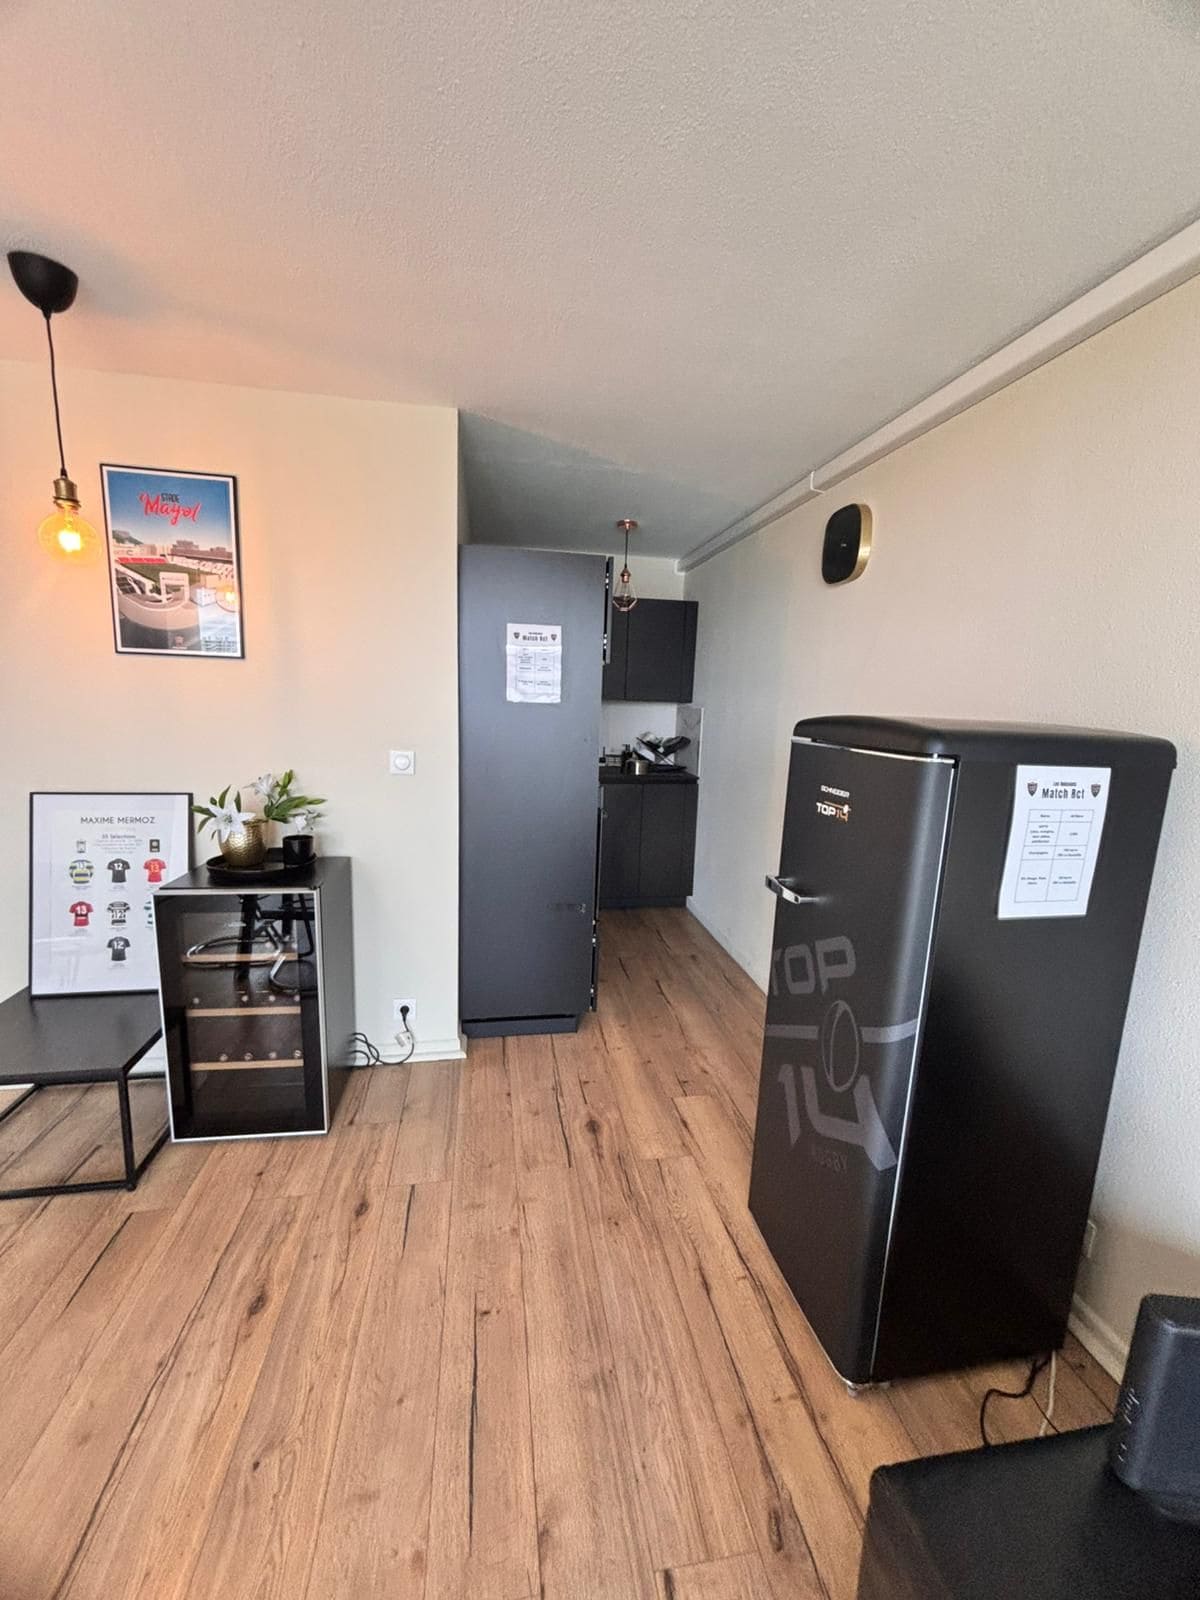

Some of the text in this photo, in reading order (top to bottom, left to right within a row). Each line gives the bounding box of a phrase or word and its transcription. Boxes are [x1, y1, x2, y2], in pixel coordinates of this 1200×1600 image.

[139, 492, 202, 526] Mayol
[1042, 788, 1069, 799] Match
[80, 816, 156, 824] MAXIME MERMOZ
[113, 862, 123, 870] 12
[113, 940, 126, 950] 12
